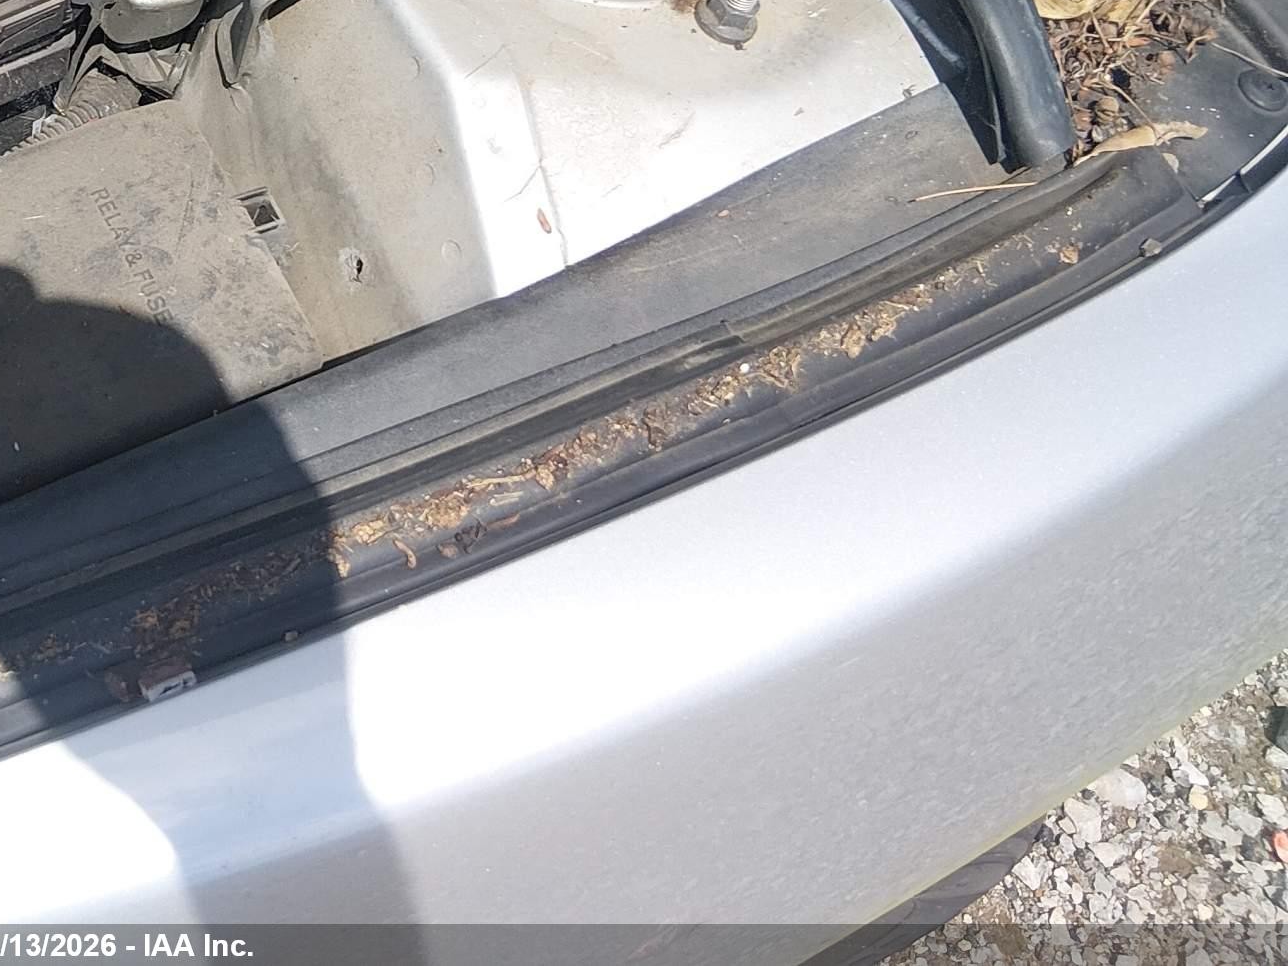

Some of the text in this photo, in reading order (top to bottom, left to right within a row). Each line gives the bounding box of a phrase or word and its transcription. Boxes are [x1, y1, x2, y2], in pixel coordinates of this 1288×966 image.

[90, 187, 173, 326] RELAY & FUSE
